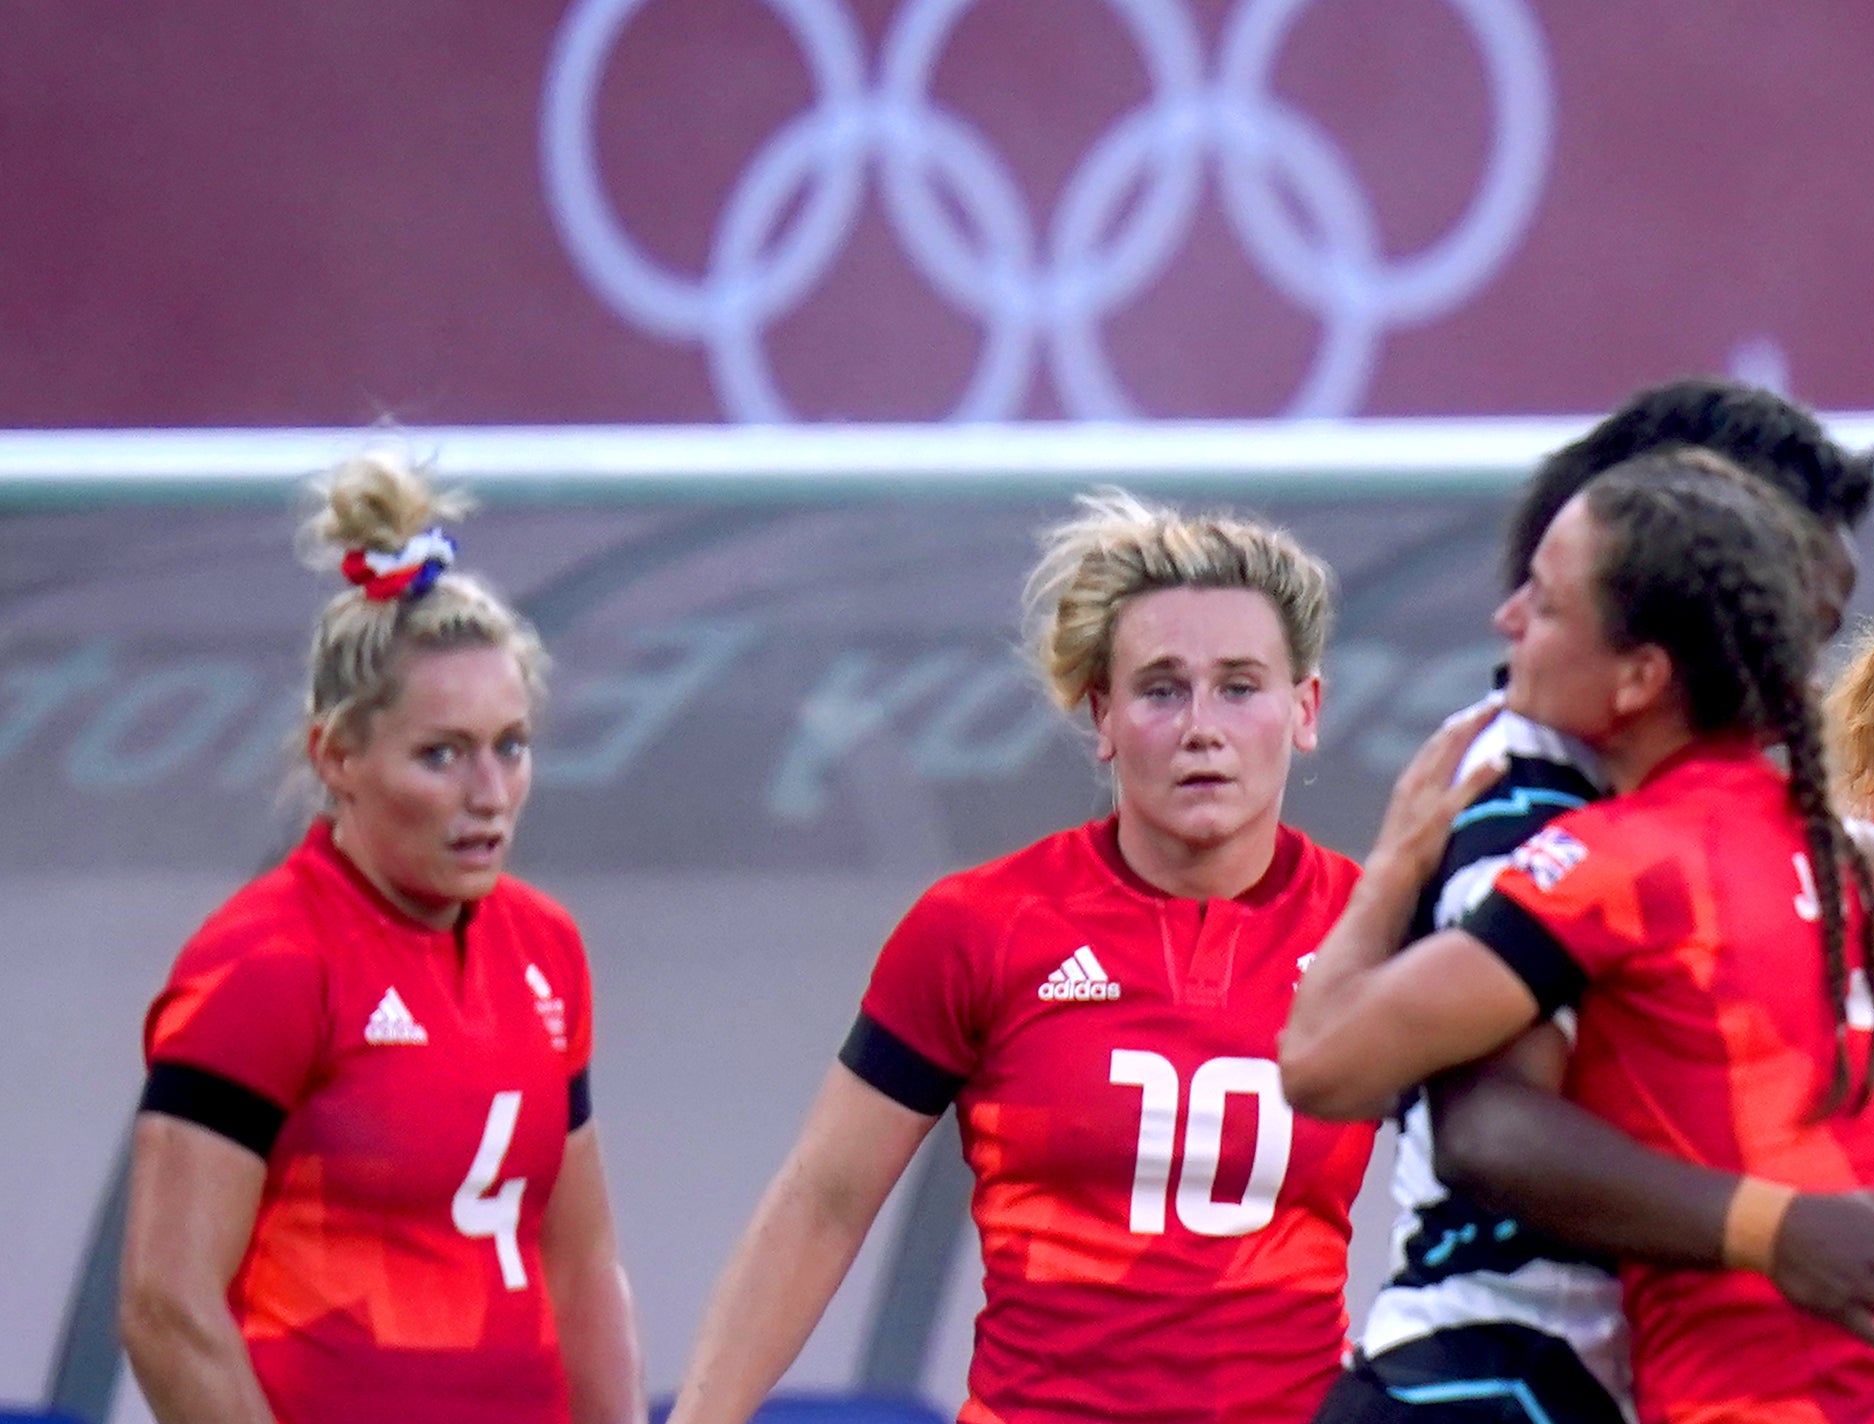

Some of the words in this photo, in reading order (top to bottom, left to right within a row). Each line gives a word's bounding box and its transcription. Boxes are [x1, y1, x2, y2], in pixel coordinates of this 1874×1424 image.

[1037, 979, 1121, 1001] adidas
[451, 1090, 528, 1290] 4
[1109, 1048, 1294, 1237] 10
